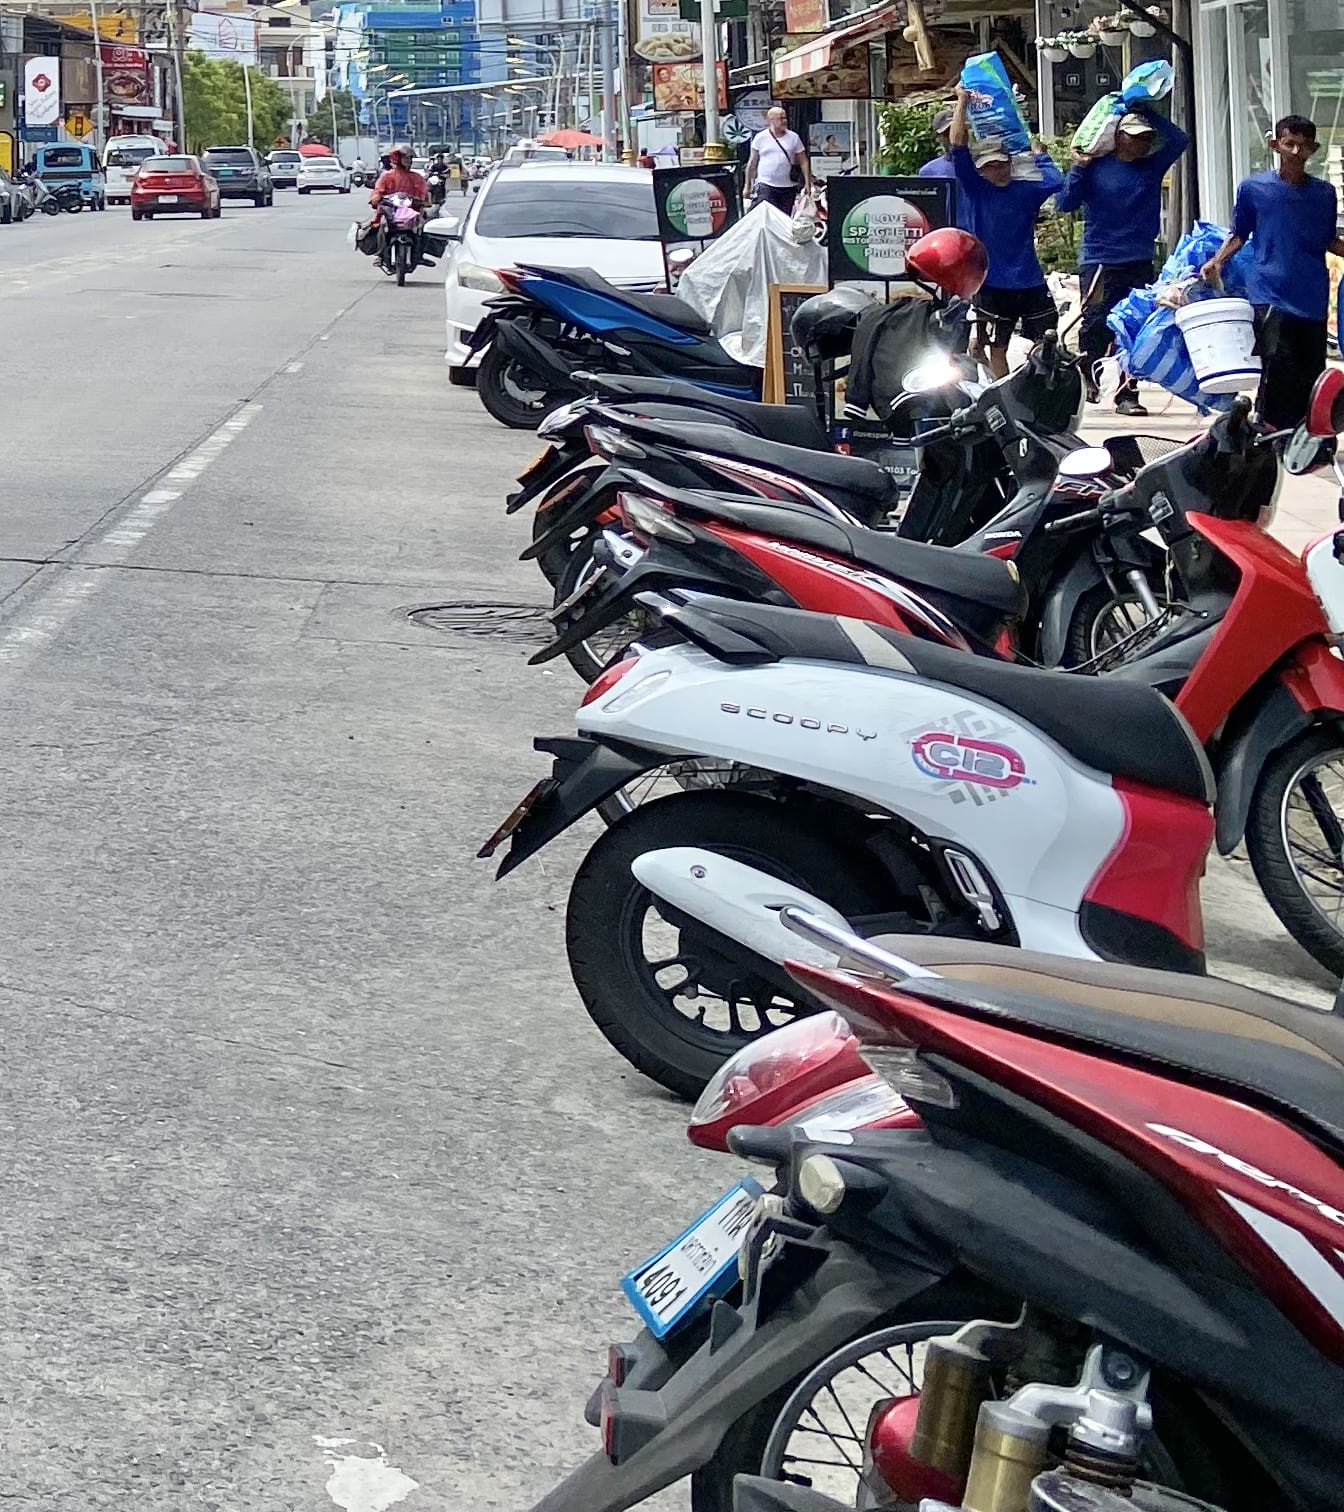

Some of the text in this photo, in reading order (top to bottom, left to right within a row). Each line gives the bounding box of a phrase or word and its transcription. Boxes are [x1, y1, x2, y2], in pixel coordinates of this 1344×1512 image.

[874, 213, 908, 225] LOVE
[848, 226, 924, 238] SPAGHETTI
[864, 246, 908, 259] Phuke
[720, 700, 878, 741] SCOOPY
[640, 1263, 688, 1316] 4091
